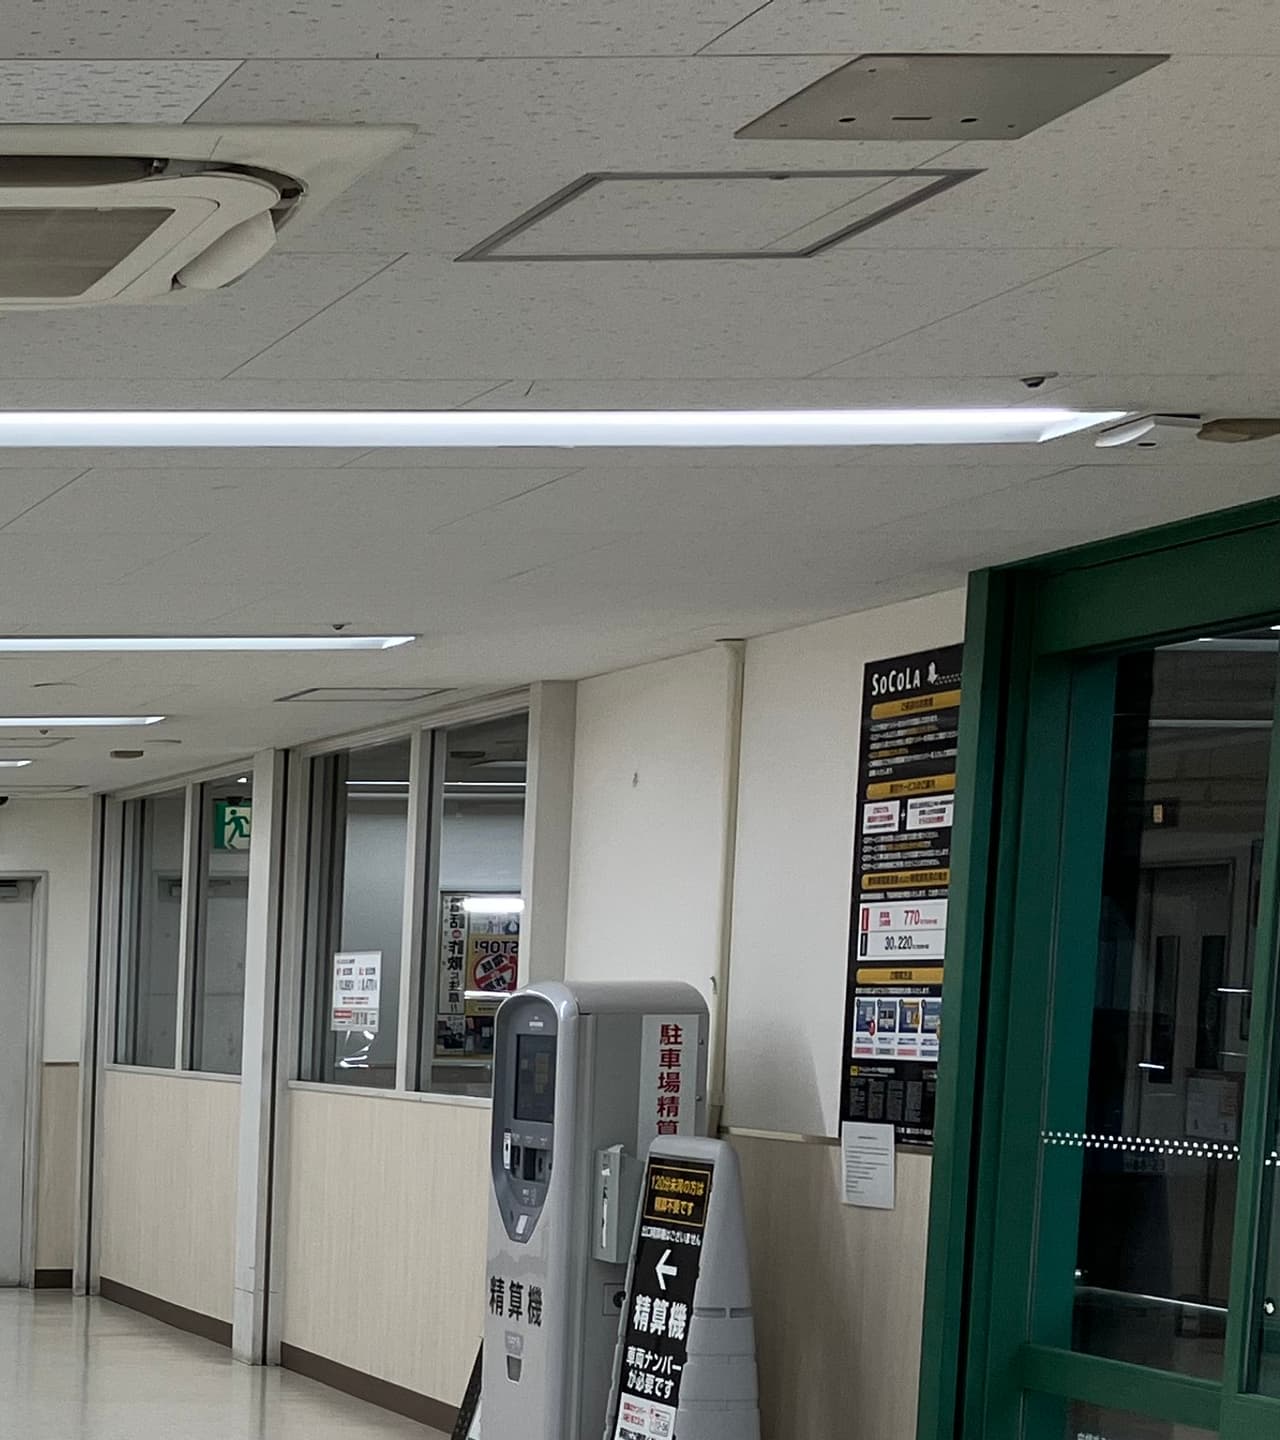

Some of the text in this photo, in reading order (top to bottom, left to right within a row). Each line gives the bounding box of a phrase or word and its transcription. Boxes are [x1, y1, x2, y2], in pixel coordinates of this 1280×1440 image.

[488, 1274, 543, 1329] 精算機
[632, 1293, 689, 1341] 精算機
[625, 1345, 683, 1375] 車両ナンバー
[626, 1369, 675, 1400] が必要です
